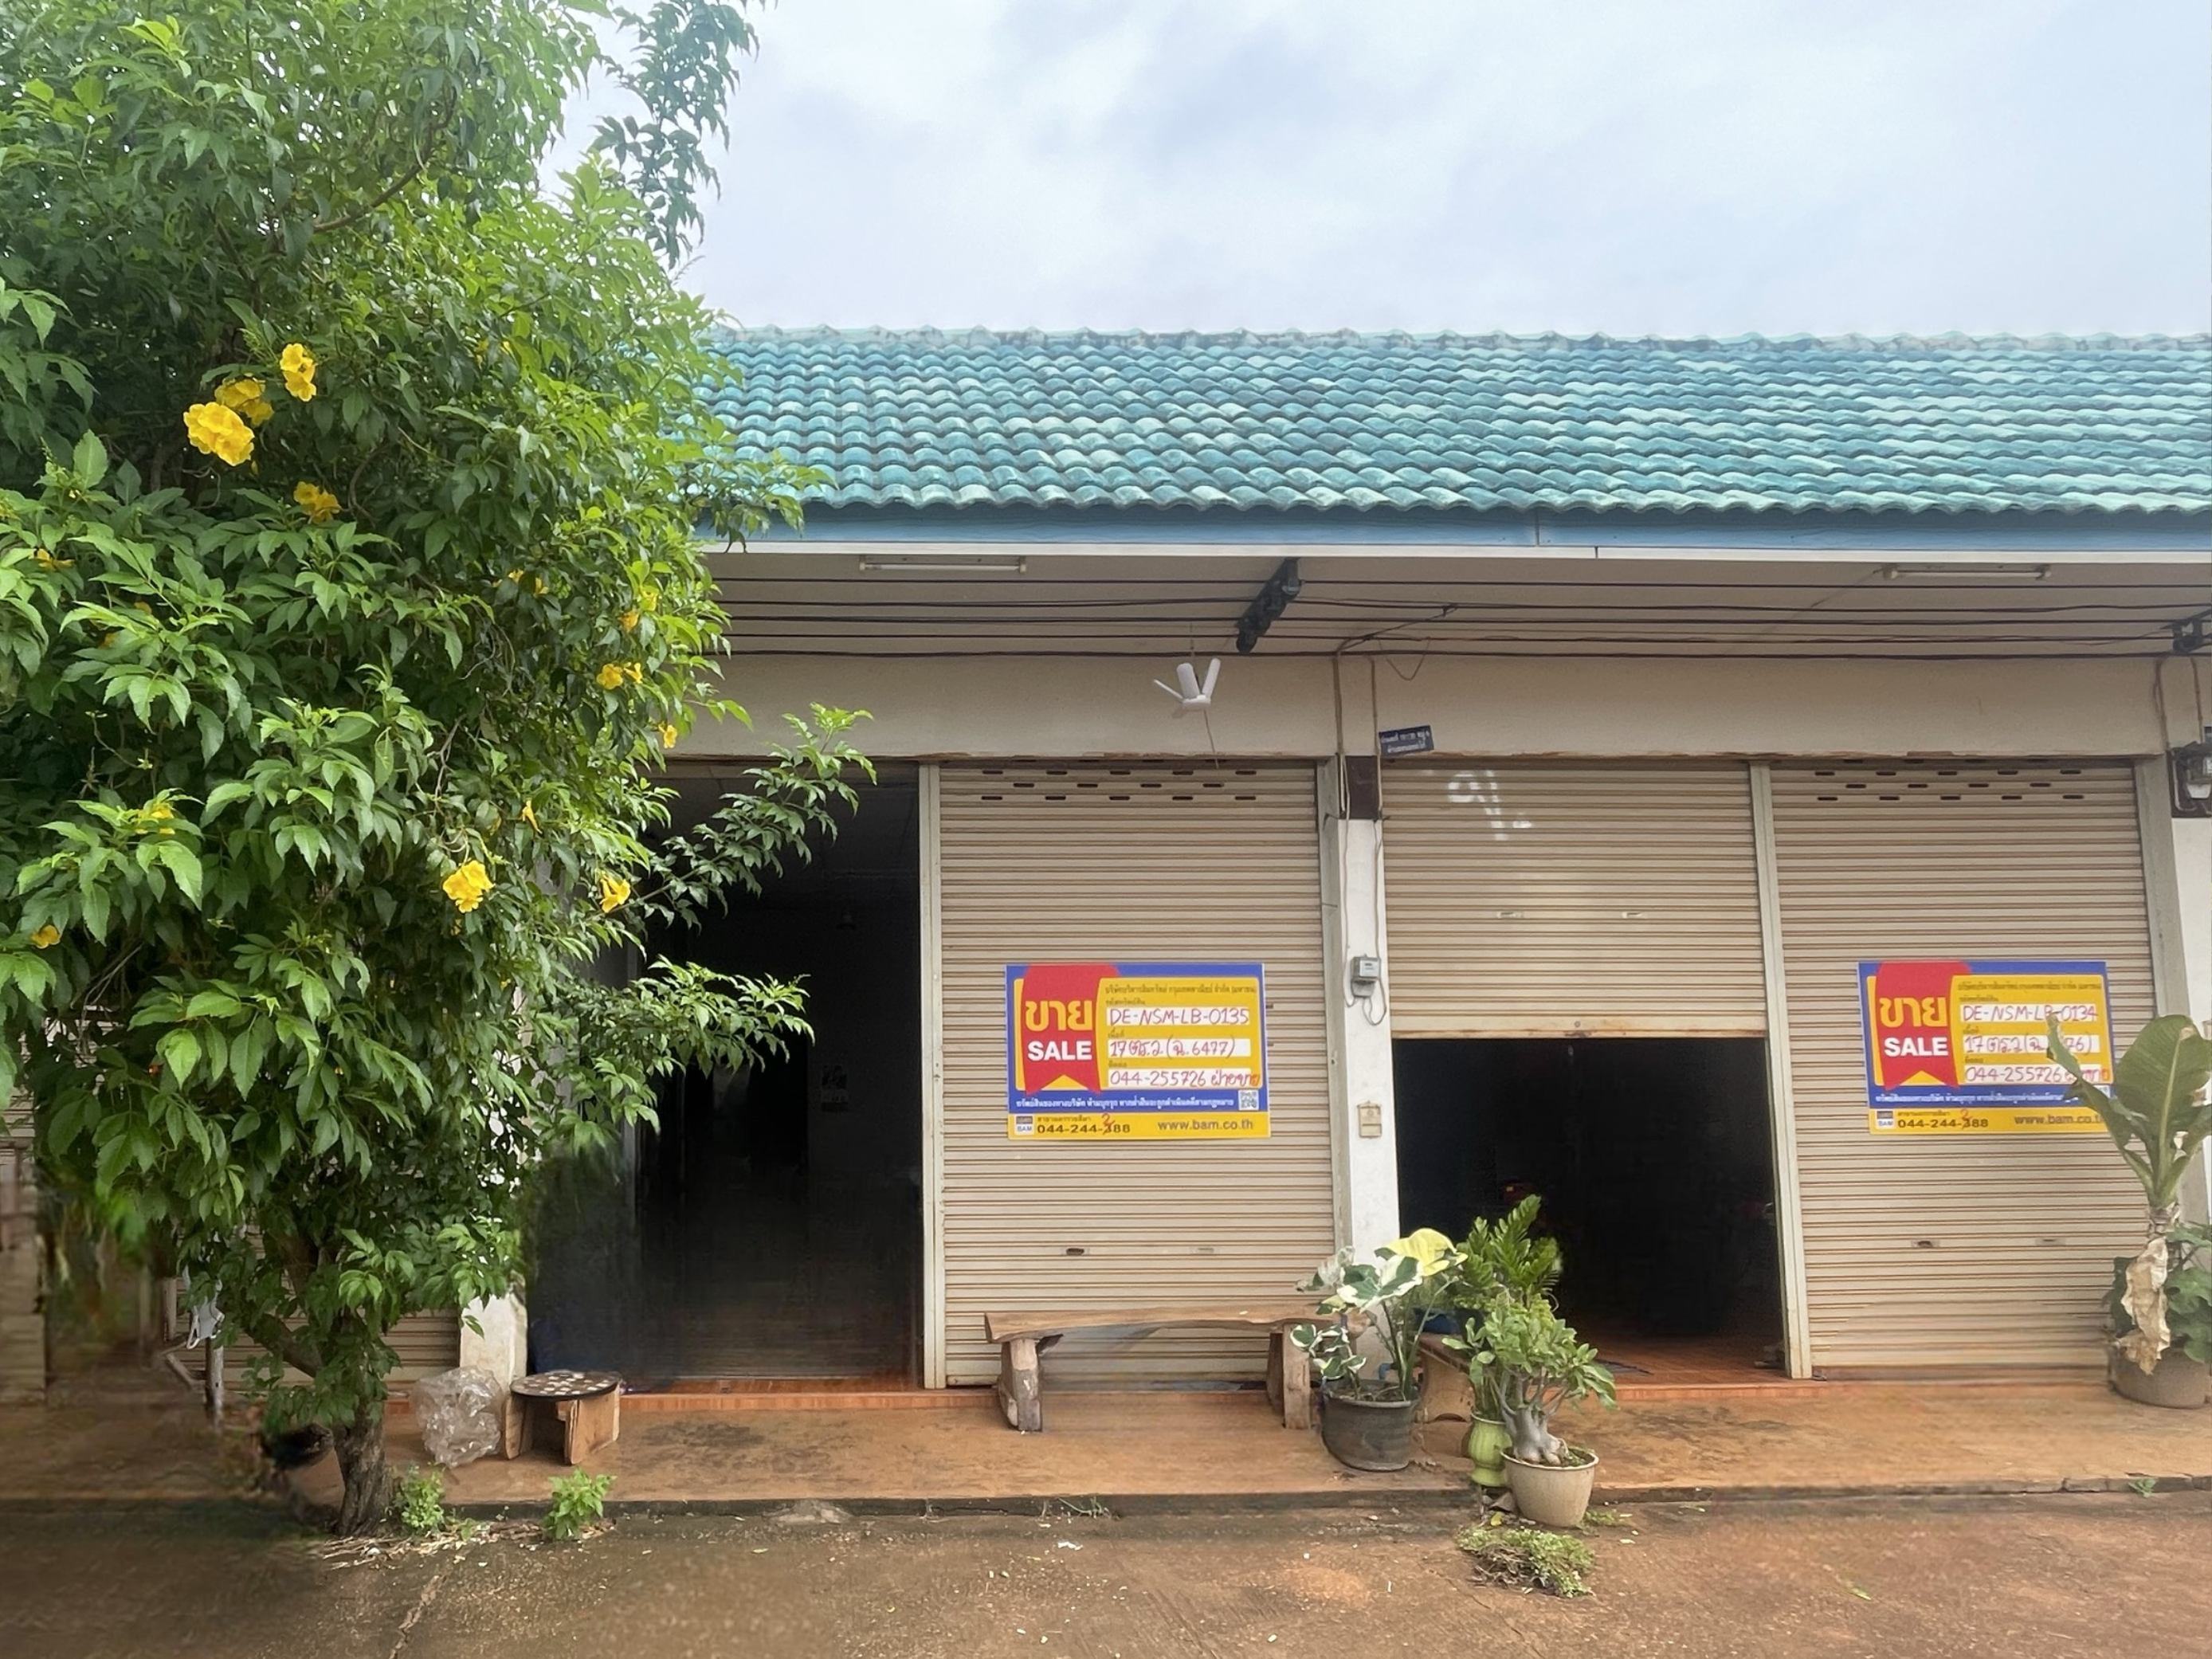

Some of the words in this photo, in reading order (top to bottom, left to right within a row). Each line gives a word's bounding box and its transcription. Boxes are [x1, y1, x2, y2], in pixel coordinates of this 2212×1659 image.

[1025, 1000, 1092, 1031] ขาย
[1110, 1007, 1249, 1026] DE-NSM-LB-0135
[1880, 997, 1947, 1027] ขาย
[1027, 1040, 1092, 1061] SALE
[1884, 1037, 1949, 1057] SALE
[1110, 1071, 1206, 1087] 044-255726
[1965, 1066, 2062, 1083] 044-255726
[1158, 1119, 1253, 1131] www.bam.co.th
[2014, 1114, 2104, 1124] www.bam.co.t
